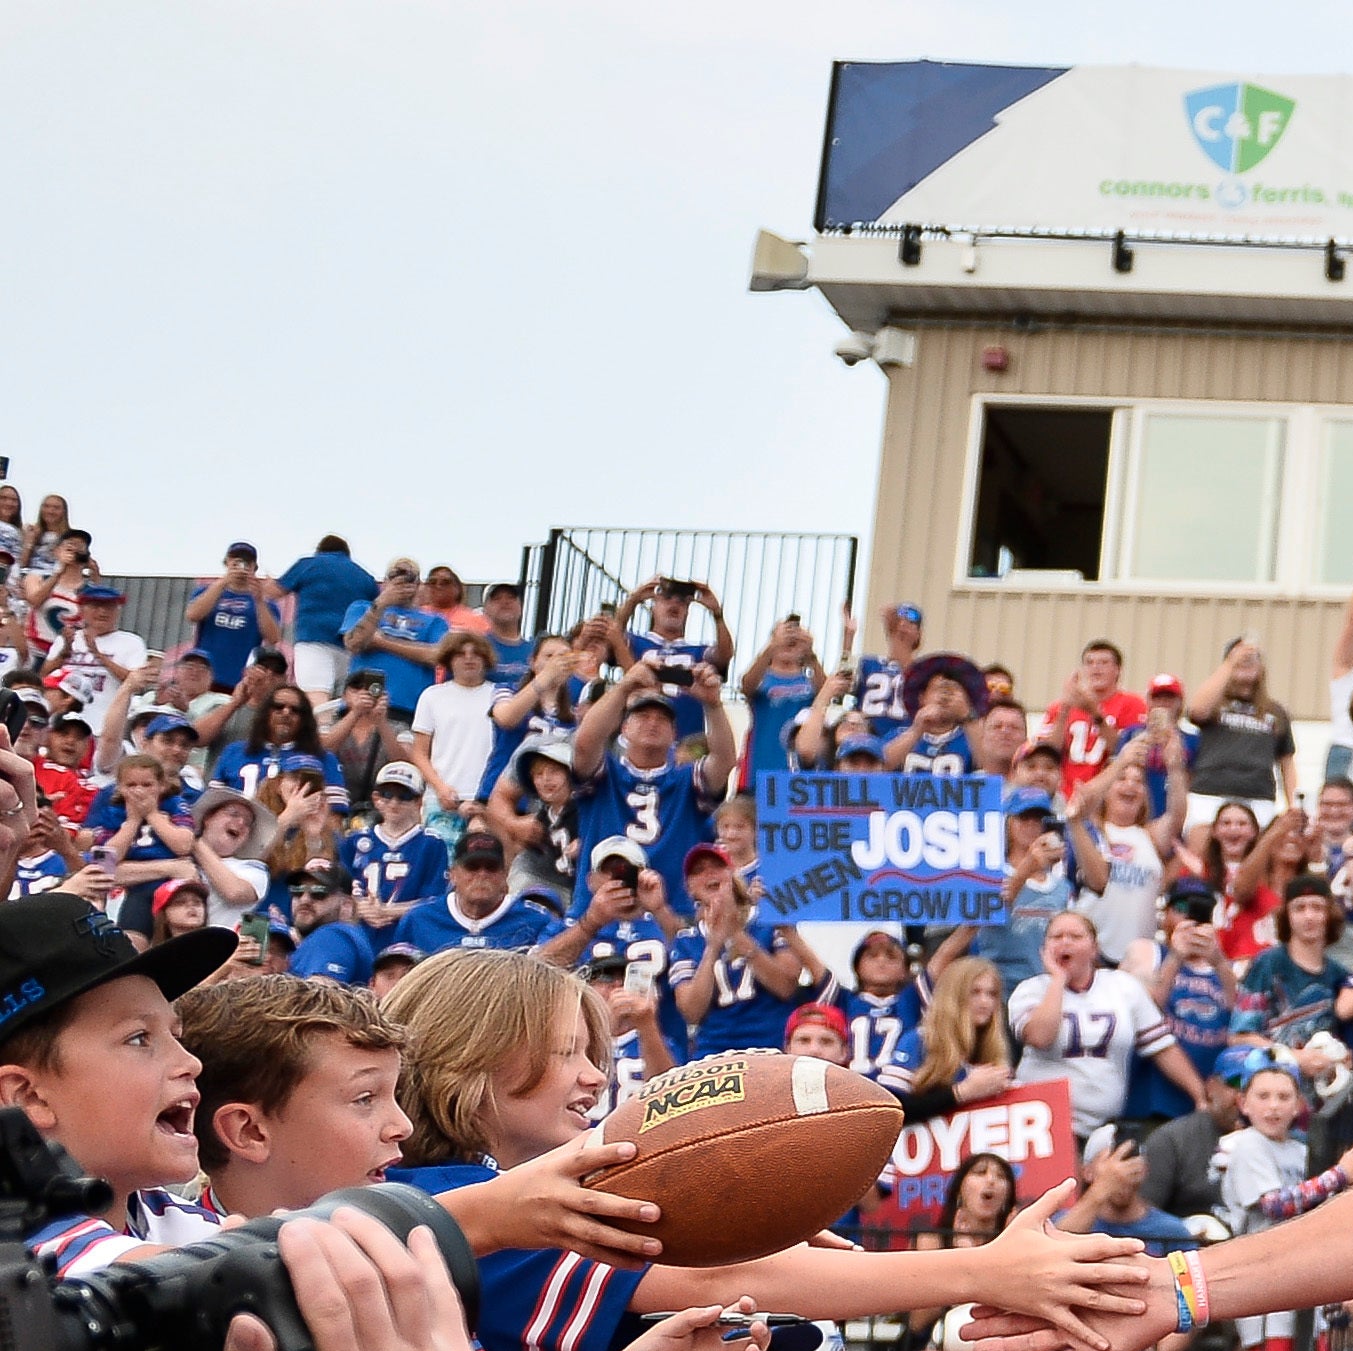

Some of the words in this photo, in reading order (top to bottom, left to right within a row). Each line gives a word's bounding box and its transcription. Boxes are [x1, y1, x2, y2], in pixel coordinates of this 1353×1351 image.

[1099, 179, 1210, 200] connors
[861, 671, 907, 721] 21
[766, 776, 776, 806] I
[789, 776, 879, 807] STILL
[891, 776, 985, 808] WANT
[626, 791, 661, 845] 3
[760, 822, 802, 851] TO
[810, 822, 850, 850] BE
[851, 810, 1004, 870] JOSH
[766, 854, 862, 914] WHEN
[840, 890, 850, 920] I
[857, 890, 951, 920] GROW
[958, 891, 1005, 921] UP
[849, 1015, 903, 1074] 17
[1062, 1012, 1118, 1059] 17
[638, 1061, 746, 1101] Wilson
[645, 1074, 742, 1123] NCAA
